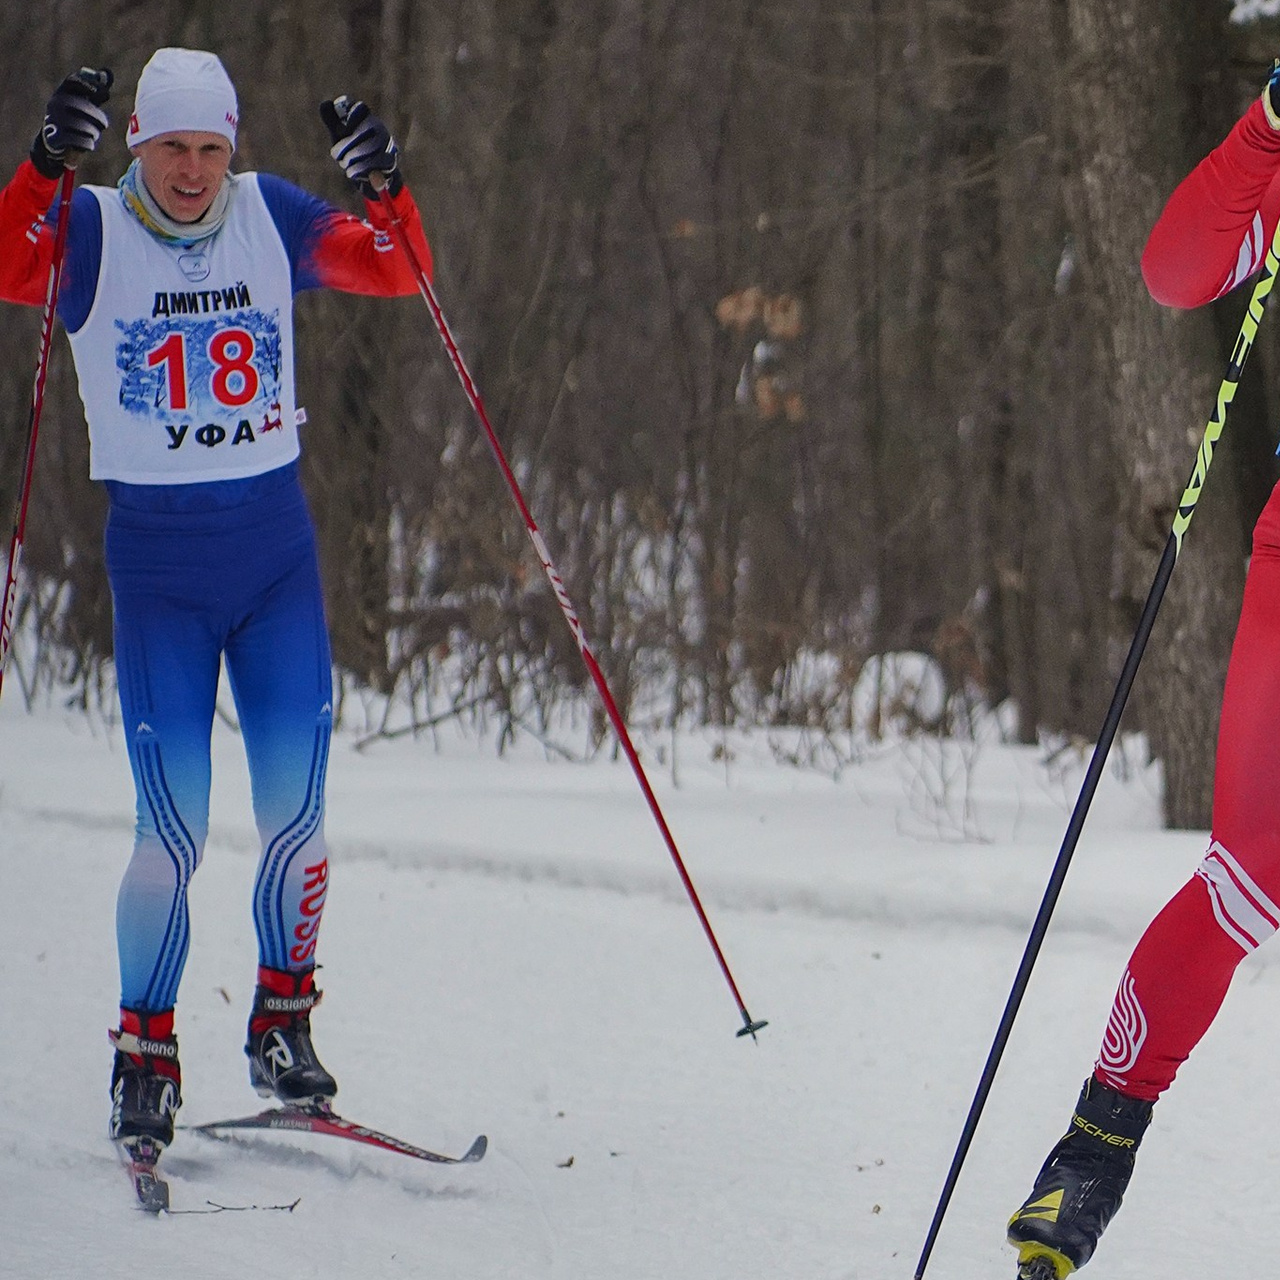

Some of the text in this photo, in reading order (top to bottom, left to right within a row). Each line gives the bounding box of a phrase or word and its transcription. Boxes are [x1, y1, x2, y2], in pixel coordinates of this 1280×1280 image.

[152, 281, 252, 318] ДМИТРИЙ
[147, 328, 259, 411] 18
[165, 419, 256, 450] УФА
[1073, 1114, 1135, 1149] ISCHER
